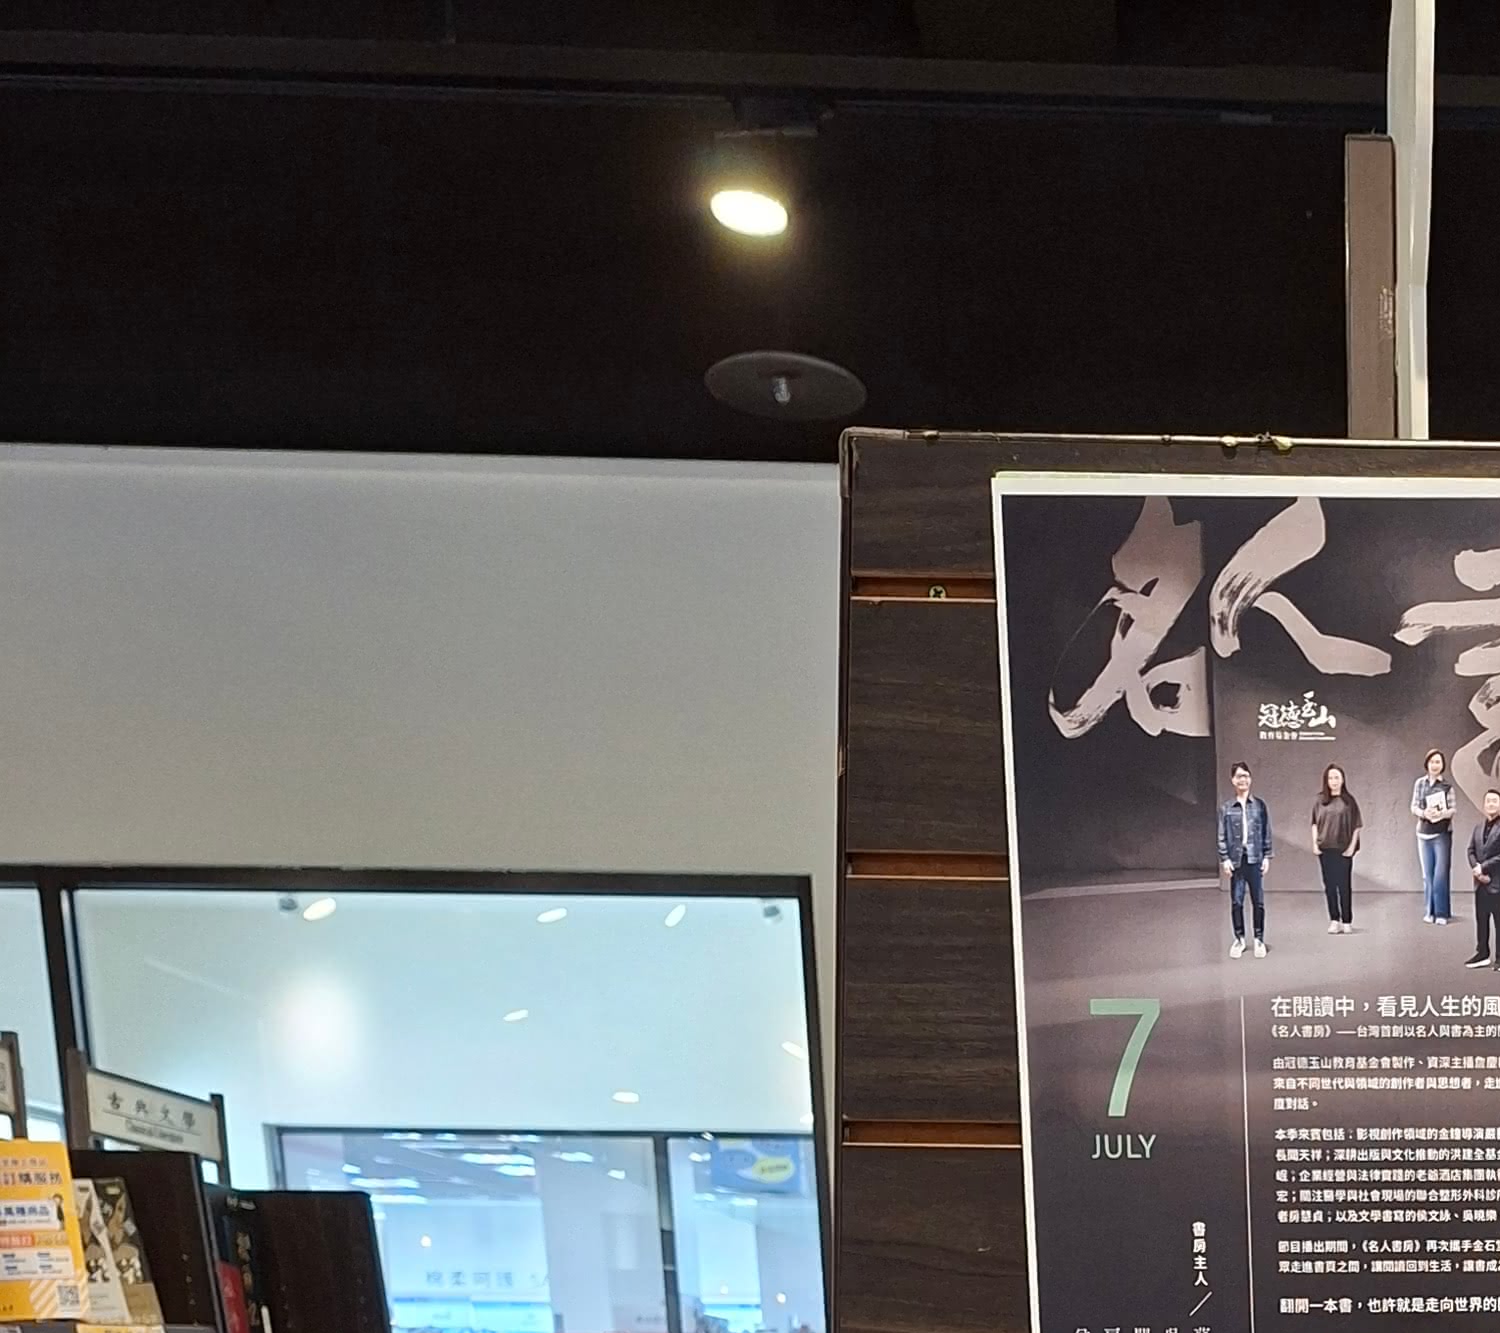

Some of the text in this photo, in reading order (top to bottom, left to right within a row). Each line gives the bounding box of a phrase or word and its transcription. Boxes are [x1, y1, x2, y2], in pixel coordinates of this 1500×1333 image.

[1089, 998, 1160, 1118] 7
[107, 1091, 196, 1130] 古典文學
[1091, 1134, 1157, 1160] JULY
[1191, 1221, 1209, 1287] 書房主人
